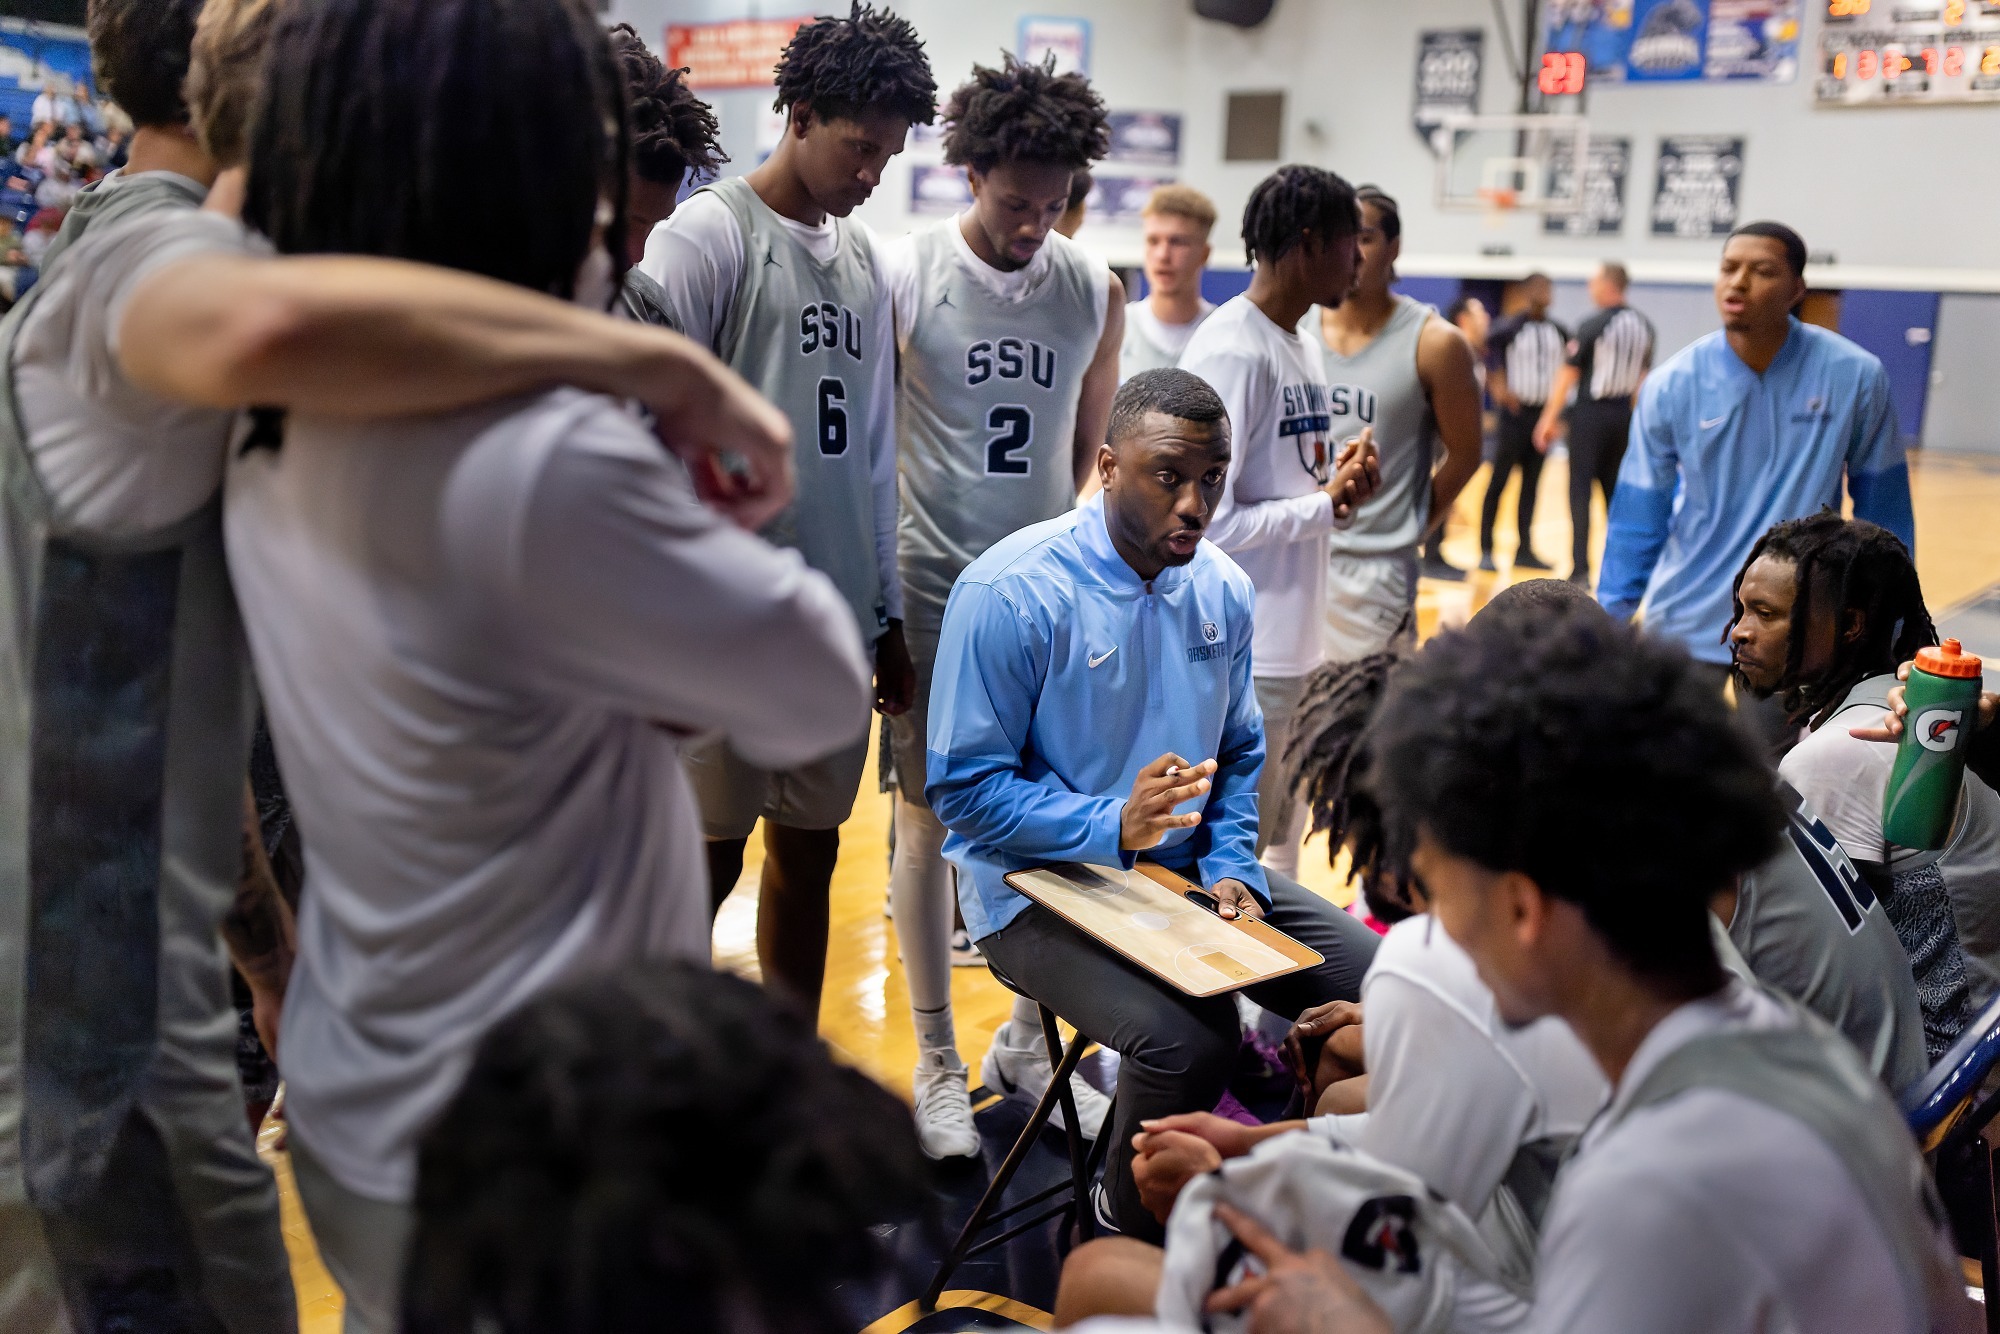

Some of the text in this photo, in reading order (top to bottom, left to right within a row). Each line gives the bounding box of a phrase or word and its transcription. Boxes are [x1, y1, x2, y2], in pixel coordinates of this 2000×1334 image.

[1538, 52, 1586, 94] 23
[801, 301, 862, 363] SSU
[966, 337, 1057, 390] SSU
[818, 376, 847, 458] 6
[1331, 384, 1378, 424] SU
[985, 403, 1034, 477] 2
[1187, 643, 1226, 663] BASKETB
[1915, 709, 1962, 752] G
